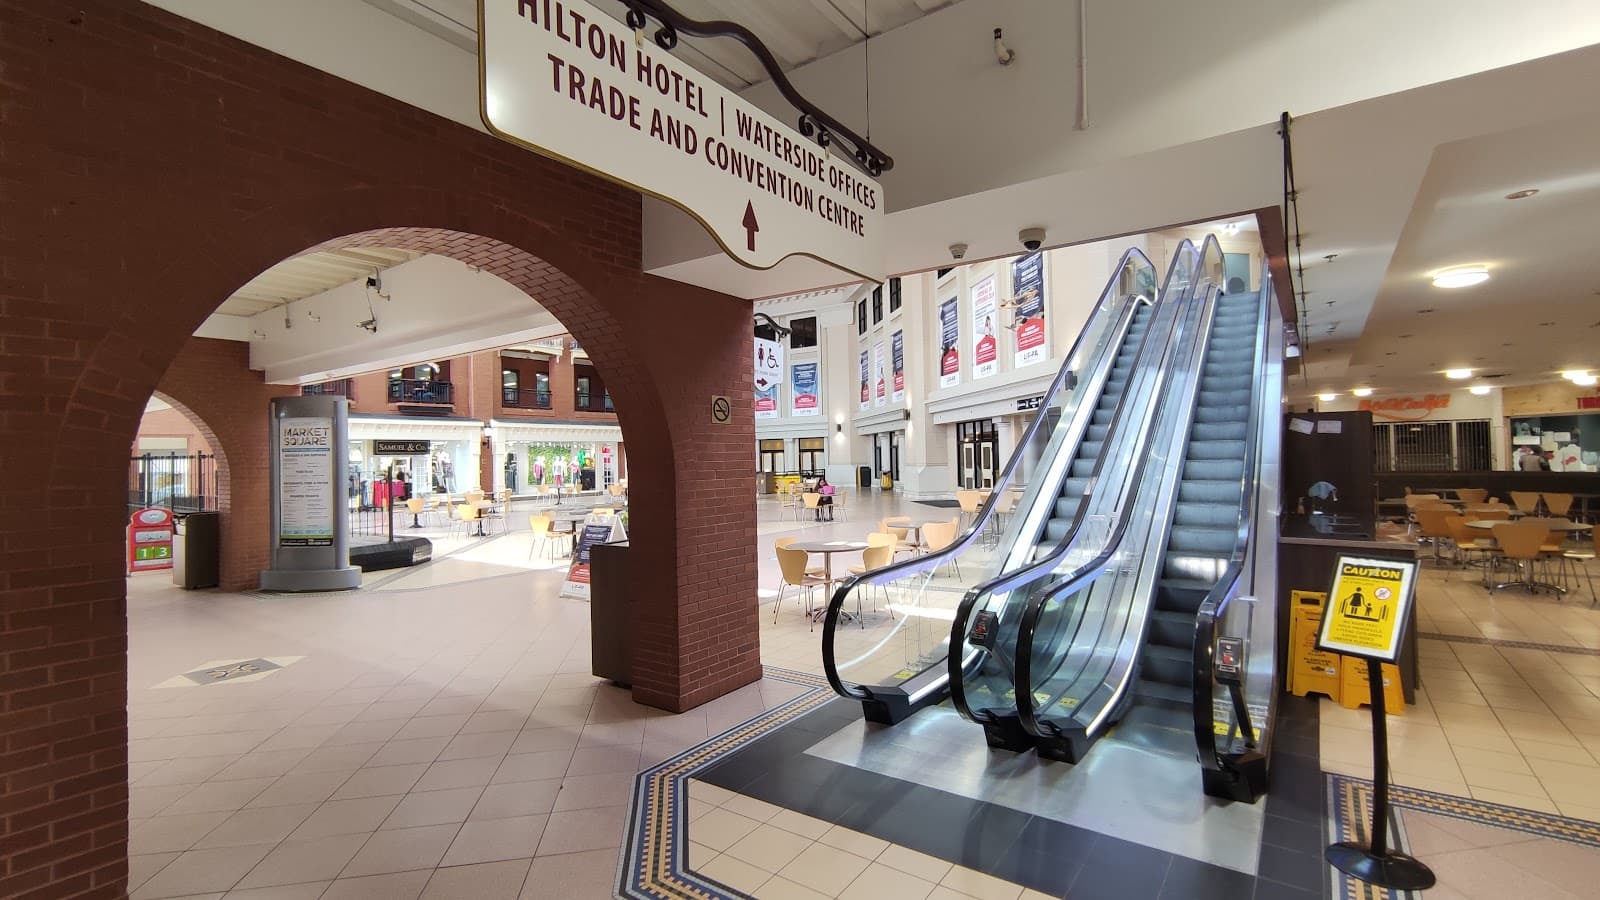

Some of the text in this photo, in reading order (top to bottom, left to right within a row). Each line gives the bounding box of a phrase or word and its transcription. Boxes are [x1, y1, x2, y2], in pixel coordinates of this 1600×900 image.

[518, 0, 876, 210] HILTON HOTEL WATERSIDE OFFICES
[547, 53, 865, 237] TRADE AND CONVENTION CENTRE
[283, 427, 329, 437] MARKET
[283, 437, 327, 446] SQUARE
[407, 443, 415, 452] &
[1343, 565, 1401, 580] CAUTION
